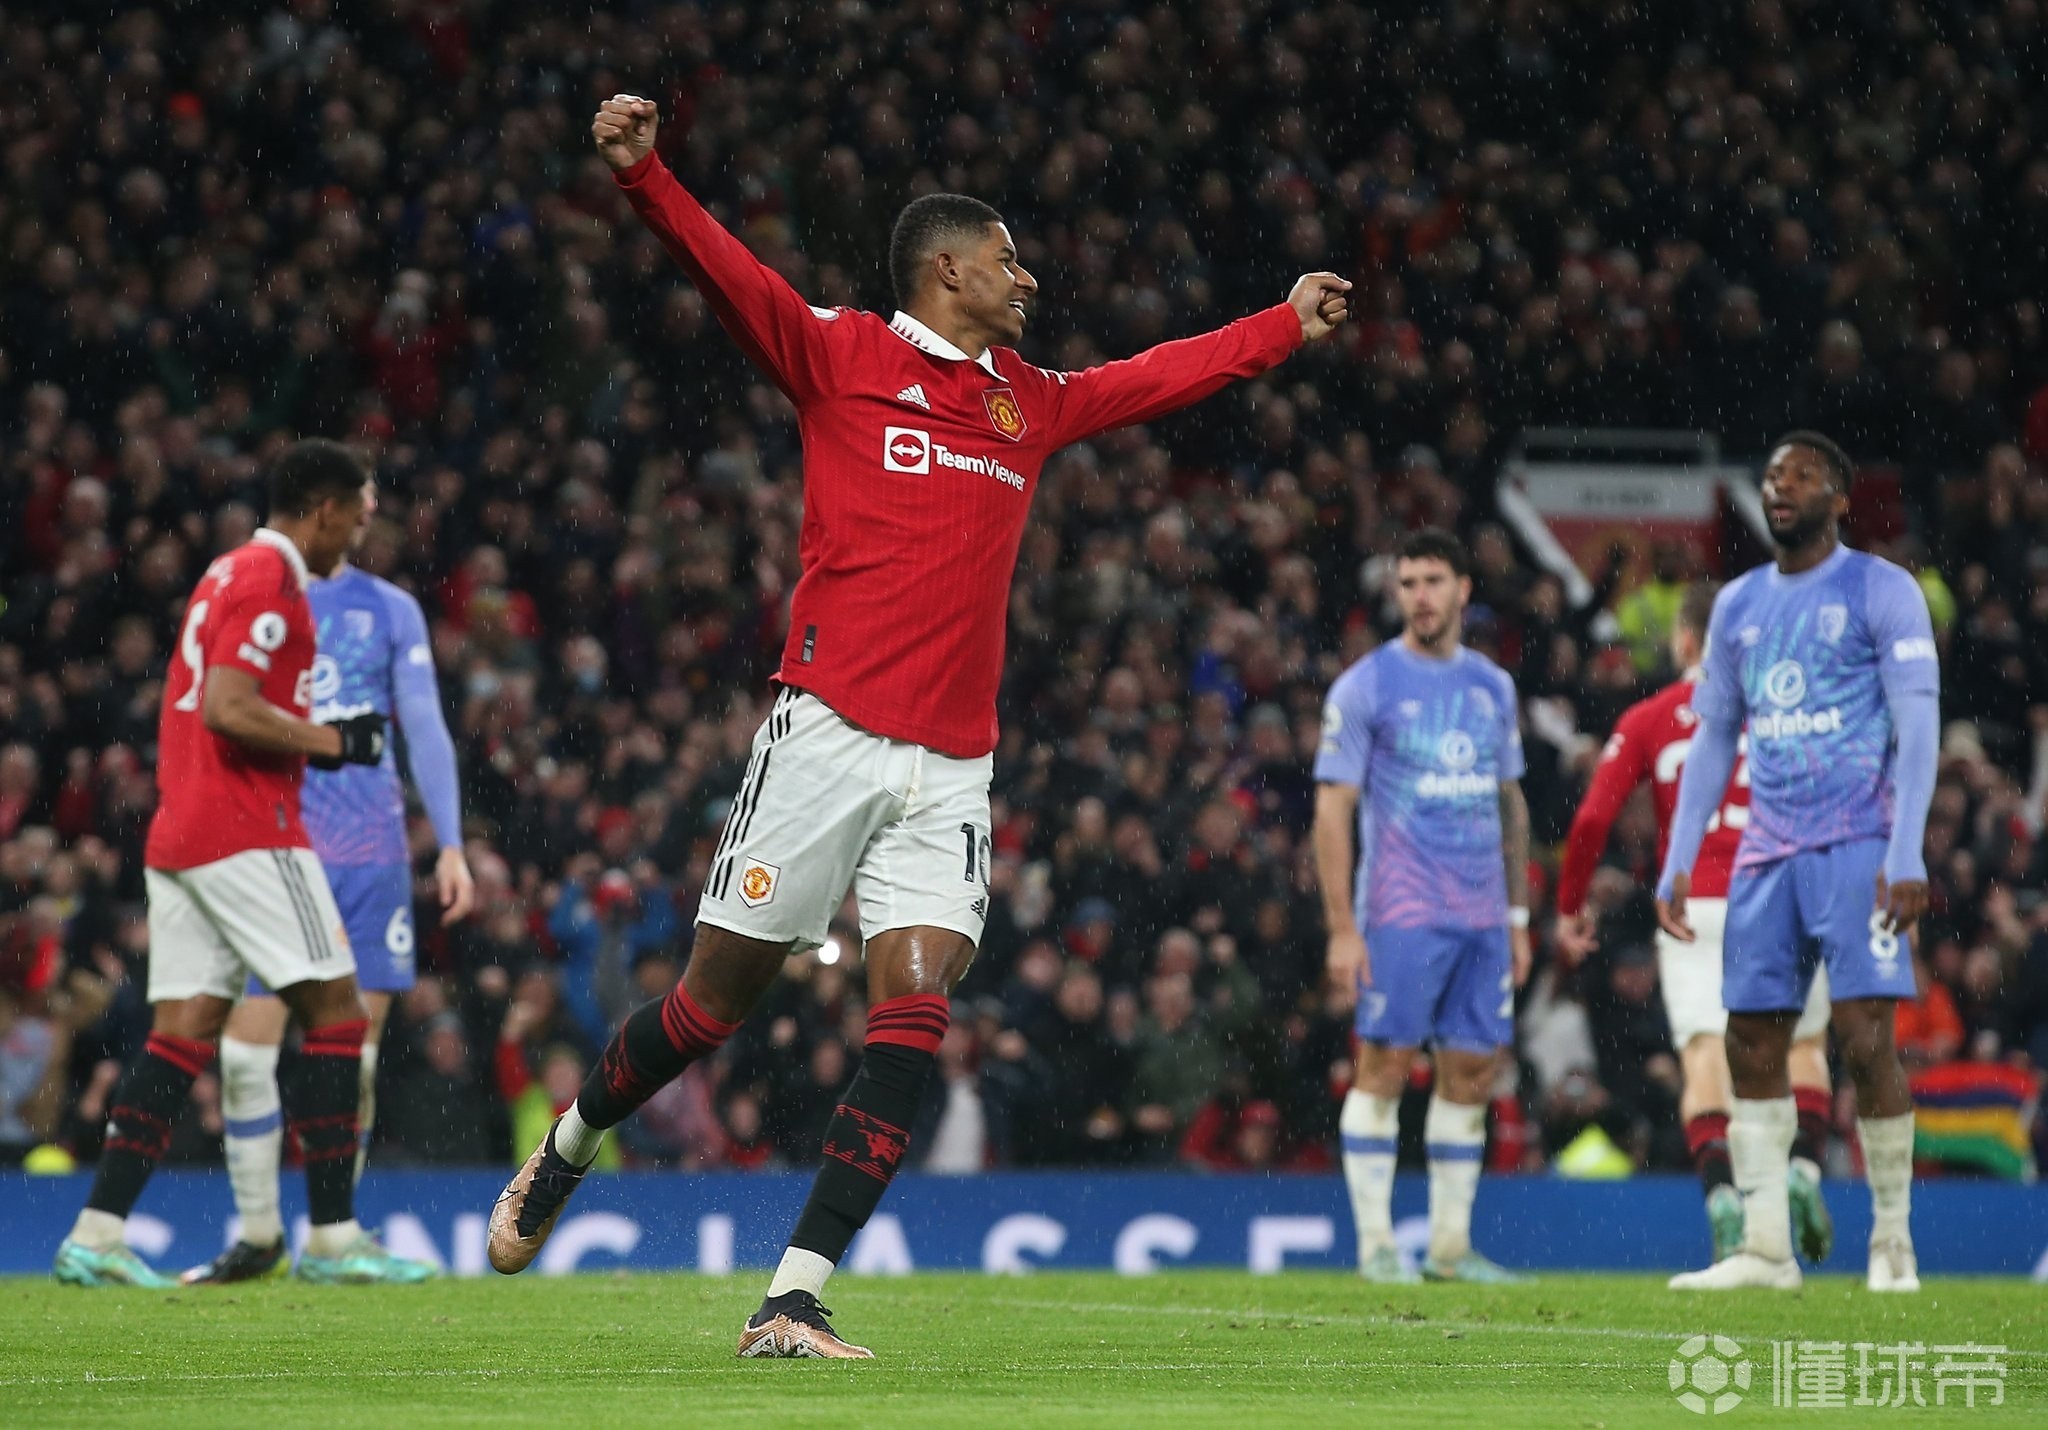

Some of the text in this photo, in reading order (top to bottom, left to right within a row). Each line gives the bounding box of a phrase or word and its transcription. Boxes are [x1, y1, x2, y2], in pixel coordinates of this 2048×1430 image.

[931, 443, 1026, 493] TeamViewer
[385, 905, 414, 956] 6
[1868, 908, 1899, 960] 8
